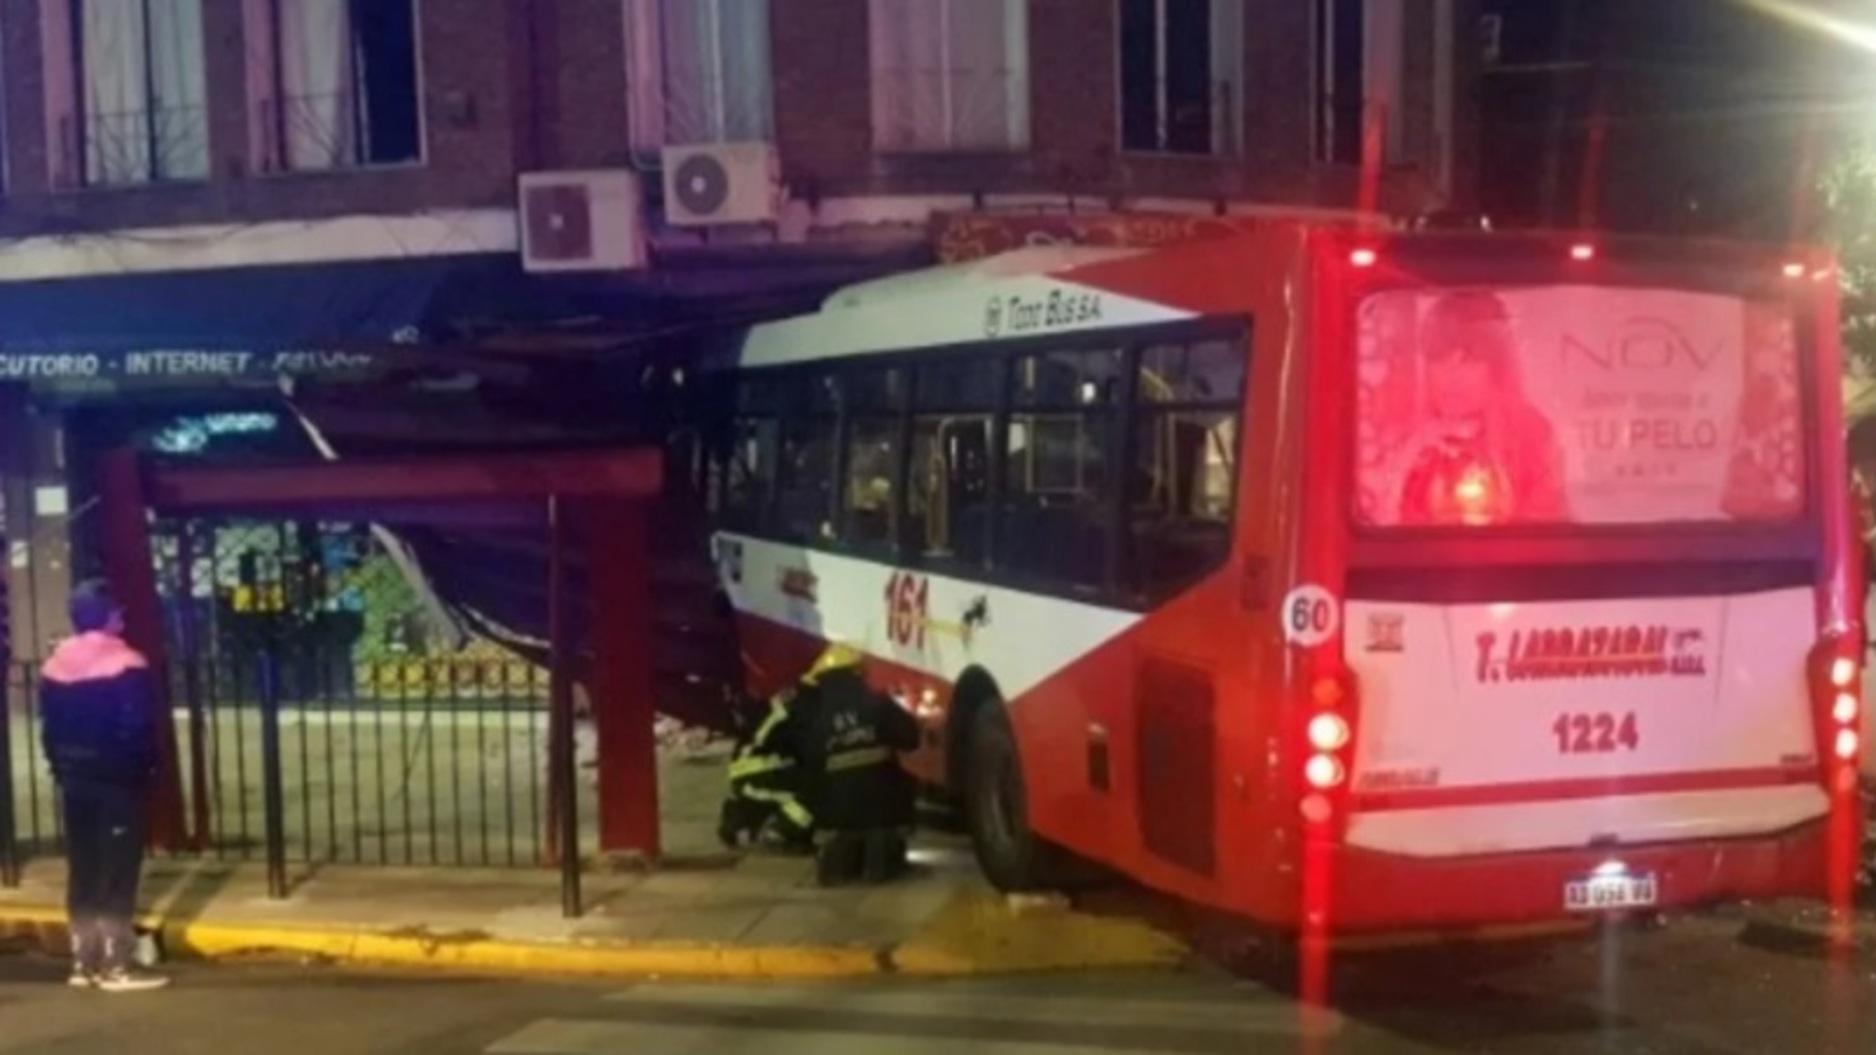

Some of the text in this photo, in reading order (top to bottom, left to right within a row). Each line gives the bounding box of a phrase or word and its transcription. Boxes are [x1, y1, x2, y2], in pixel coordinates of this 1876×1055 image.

[126, 351, 252, 374] INTERNET
[1577, 417, 1718, 451] TU PELO
[885, 570, 929, 651] 161
[1291, 596, 1331, 633] 60
[1552, 711, 1639, 754] 1224
